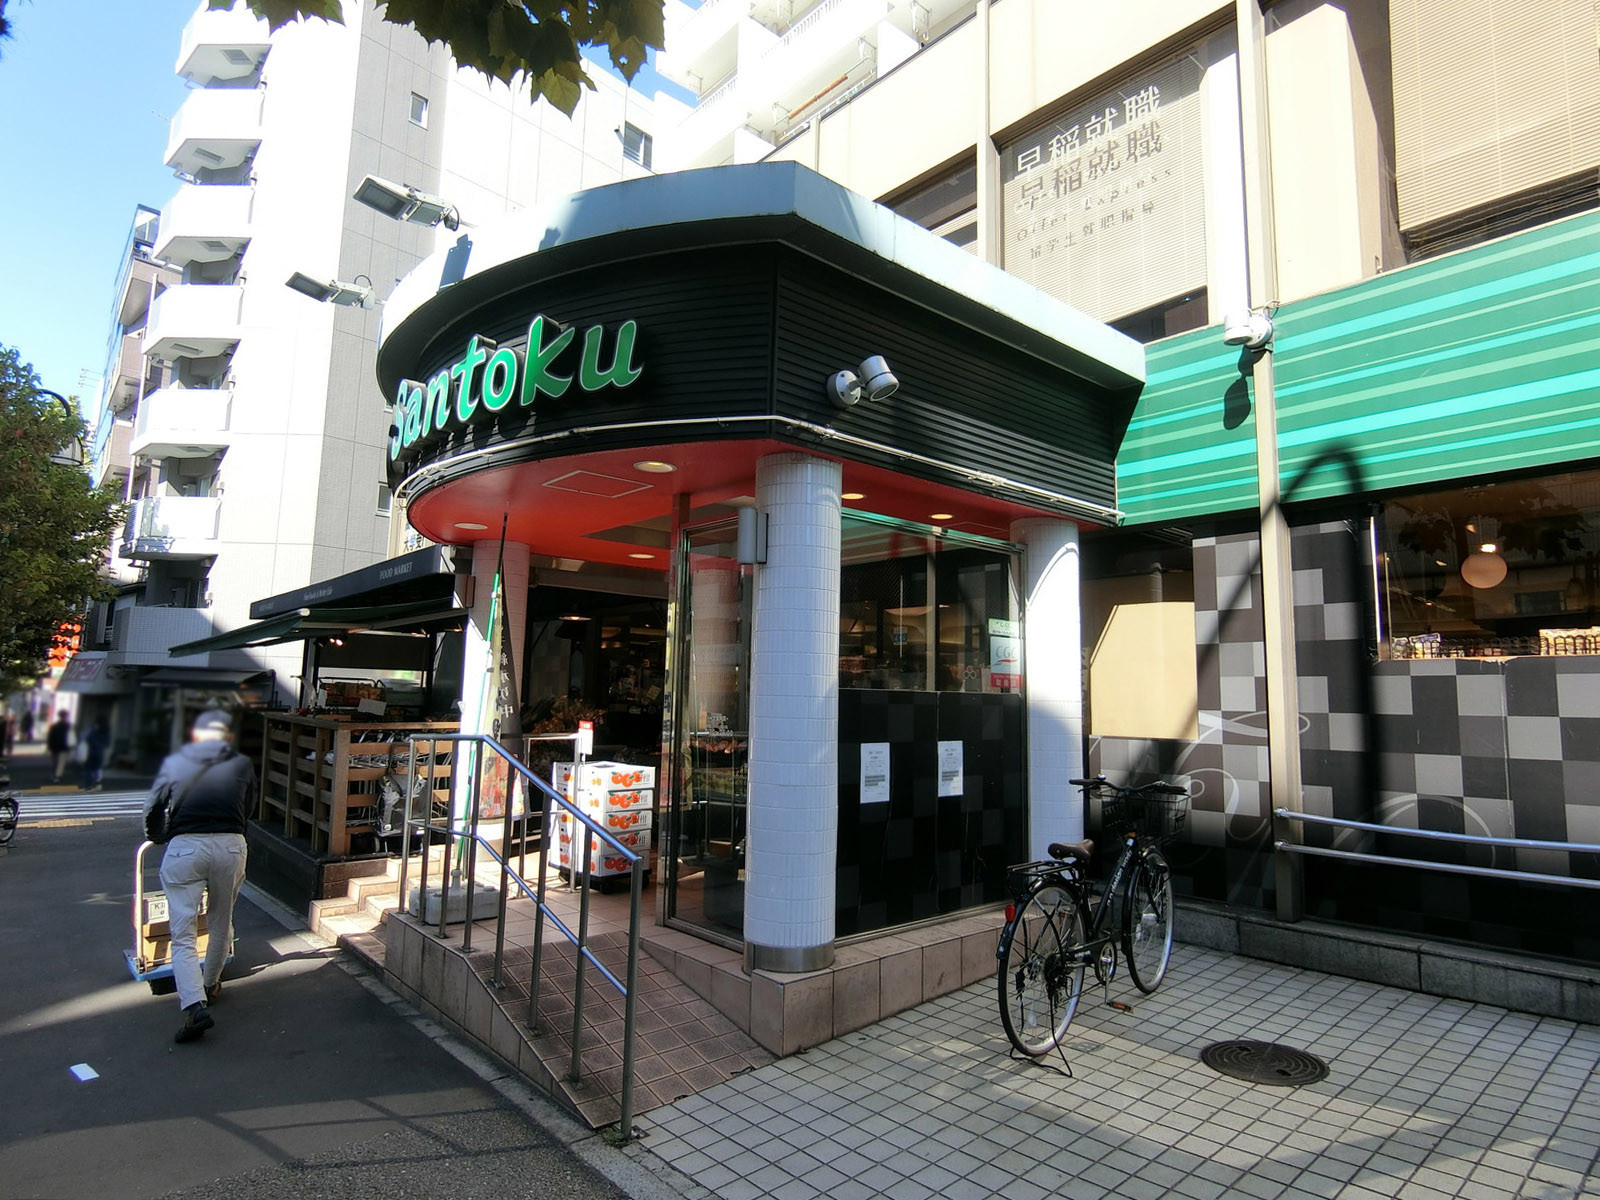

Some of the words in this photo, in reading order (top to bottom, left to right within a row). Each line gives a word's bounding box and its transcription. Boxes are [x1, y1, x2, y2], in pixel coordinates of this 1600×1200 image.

[1015, 85, 1161, 181] 早稲就職
[390, 313, 645, 462] Santoku
[379, 567, 394, 580] FOOD
[394, 561, 413, 576] MARKET
